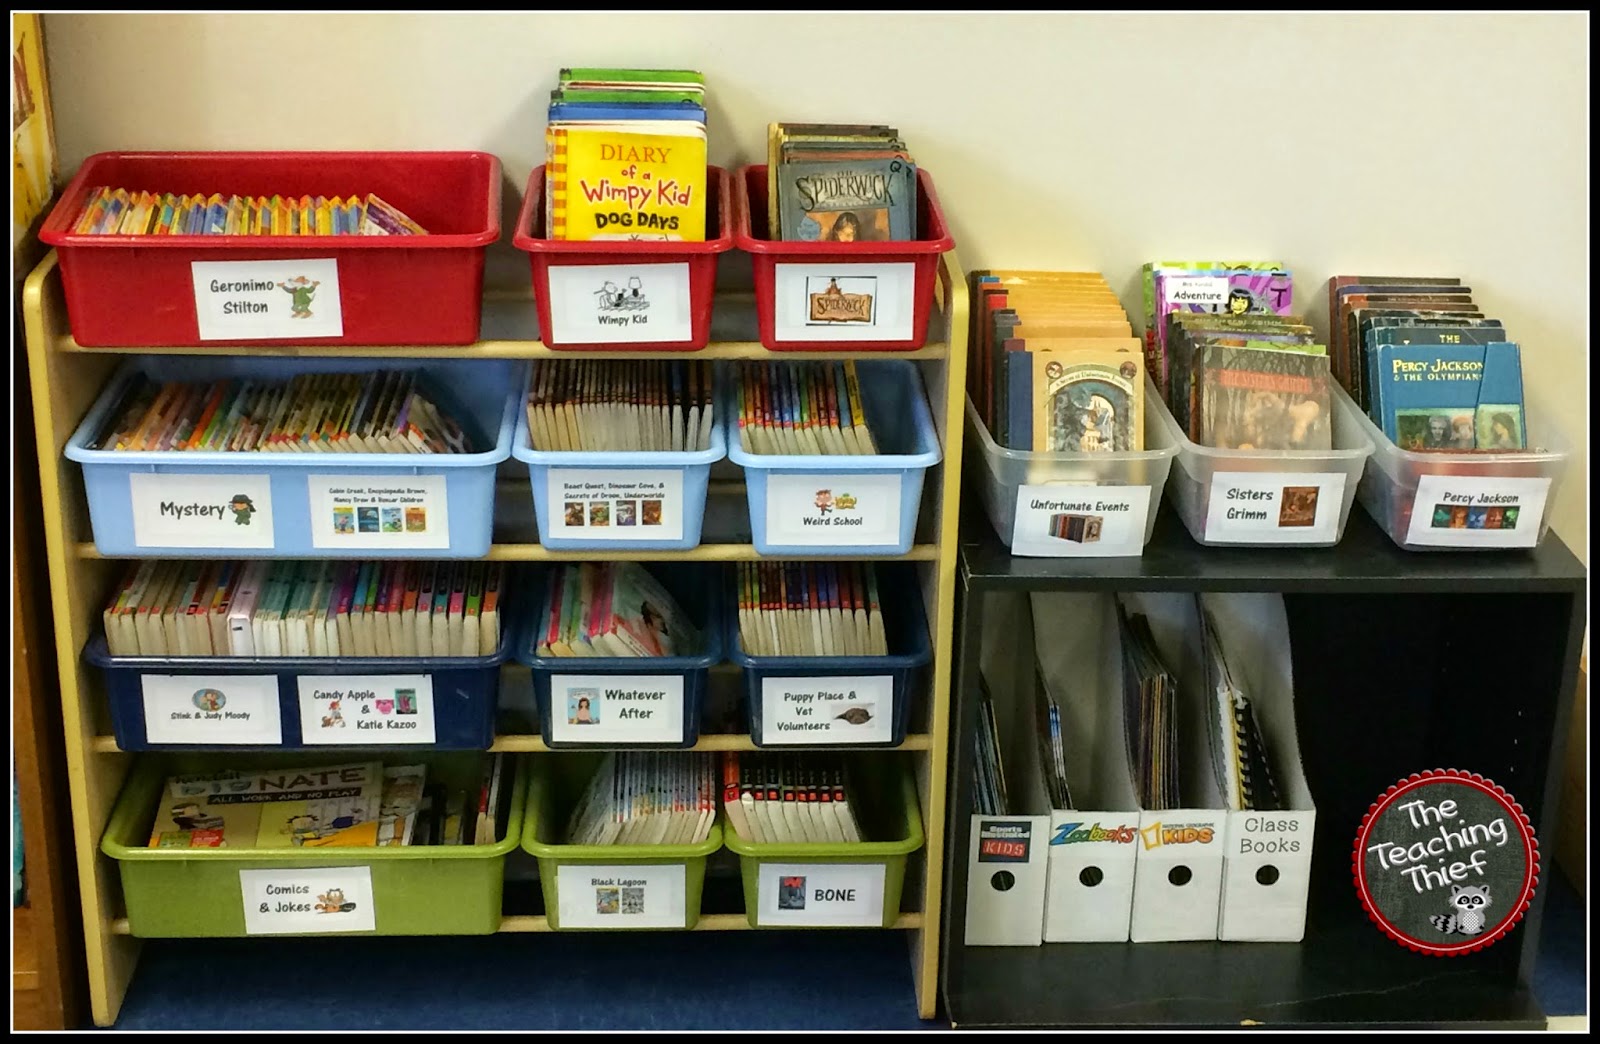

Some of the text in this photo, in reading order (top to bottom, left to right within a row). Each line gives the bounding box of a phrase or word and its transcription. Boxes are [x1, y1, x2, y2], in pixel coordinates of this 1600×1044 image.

[600, 144, 672, 164] DIARY
[621, 164, 651, 180] of a
[580, 179, 652, 210] Wimpy
[657, 179, 691, 206] Kid
[795, 174, 896, 212] SPIDERWICK
[595, 212, 679, 230] DOG DAYS
[210, 279, 274, 293] Geronimo
[1174, 291, 1221, 300] Adventure
[1270, 288, 1287, 307] T
[223, 301, 269, 314] Stilton
[598, 314, 648, 327] Wimpy Kid
[1439, 334, 1460, 344] THE
[1392, 360, 1428, 374] PERCY
[1226, 487, 1274, 501] Sisters
[1443, 492, 1519, 505] Percy Jackson
[160, 501, 226, 520] Mystery
[1030, 499, 1130, 512] Unfortunate Events
[1226, 507, 1268, 520] Grimm
[803, 516, 863, 526] Weird School
[313, 690, 376, 701] Candy Apple
[605, 689, 666, 700] Whatever
[784, 691, 857, 703] Puppy Place &
[171, 711, 192, 720] Stink
[204, 712, 222, 720] Judy
[225, 711, 251, 720] Moody
[361, 704, 371, 714] &
[619, 707, 654, 719] After
[795, 707, 813, 716] Vet
[357, 719, 417, 730] Katie Kazoo
[777, 721, 831, 731] Volunteers
[260, 767, 366, 791] NATE
[307, 791, 323, 799] NO
[1244, 817, 1299, 833] Class
[1050, 822, 1137, 846] Zoobooks
[1162, 827, 1215, 845] KIDS
[985, 842, 1024, 855] KIDS
[1240, 838, 1301, 854] Books
[591, 878, 647, 887] Black Lagoon
[266, 884, 310, 895] Comics
[814, 889, 856, 902] BONE
[259, 901, 311, 913] & Jokes
